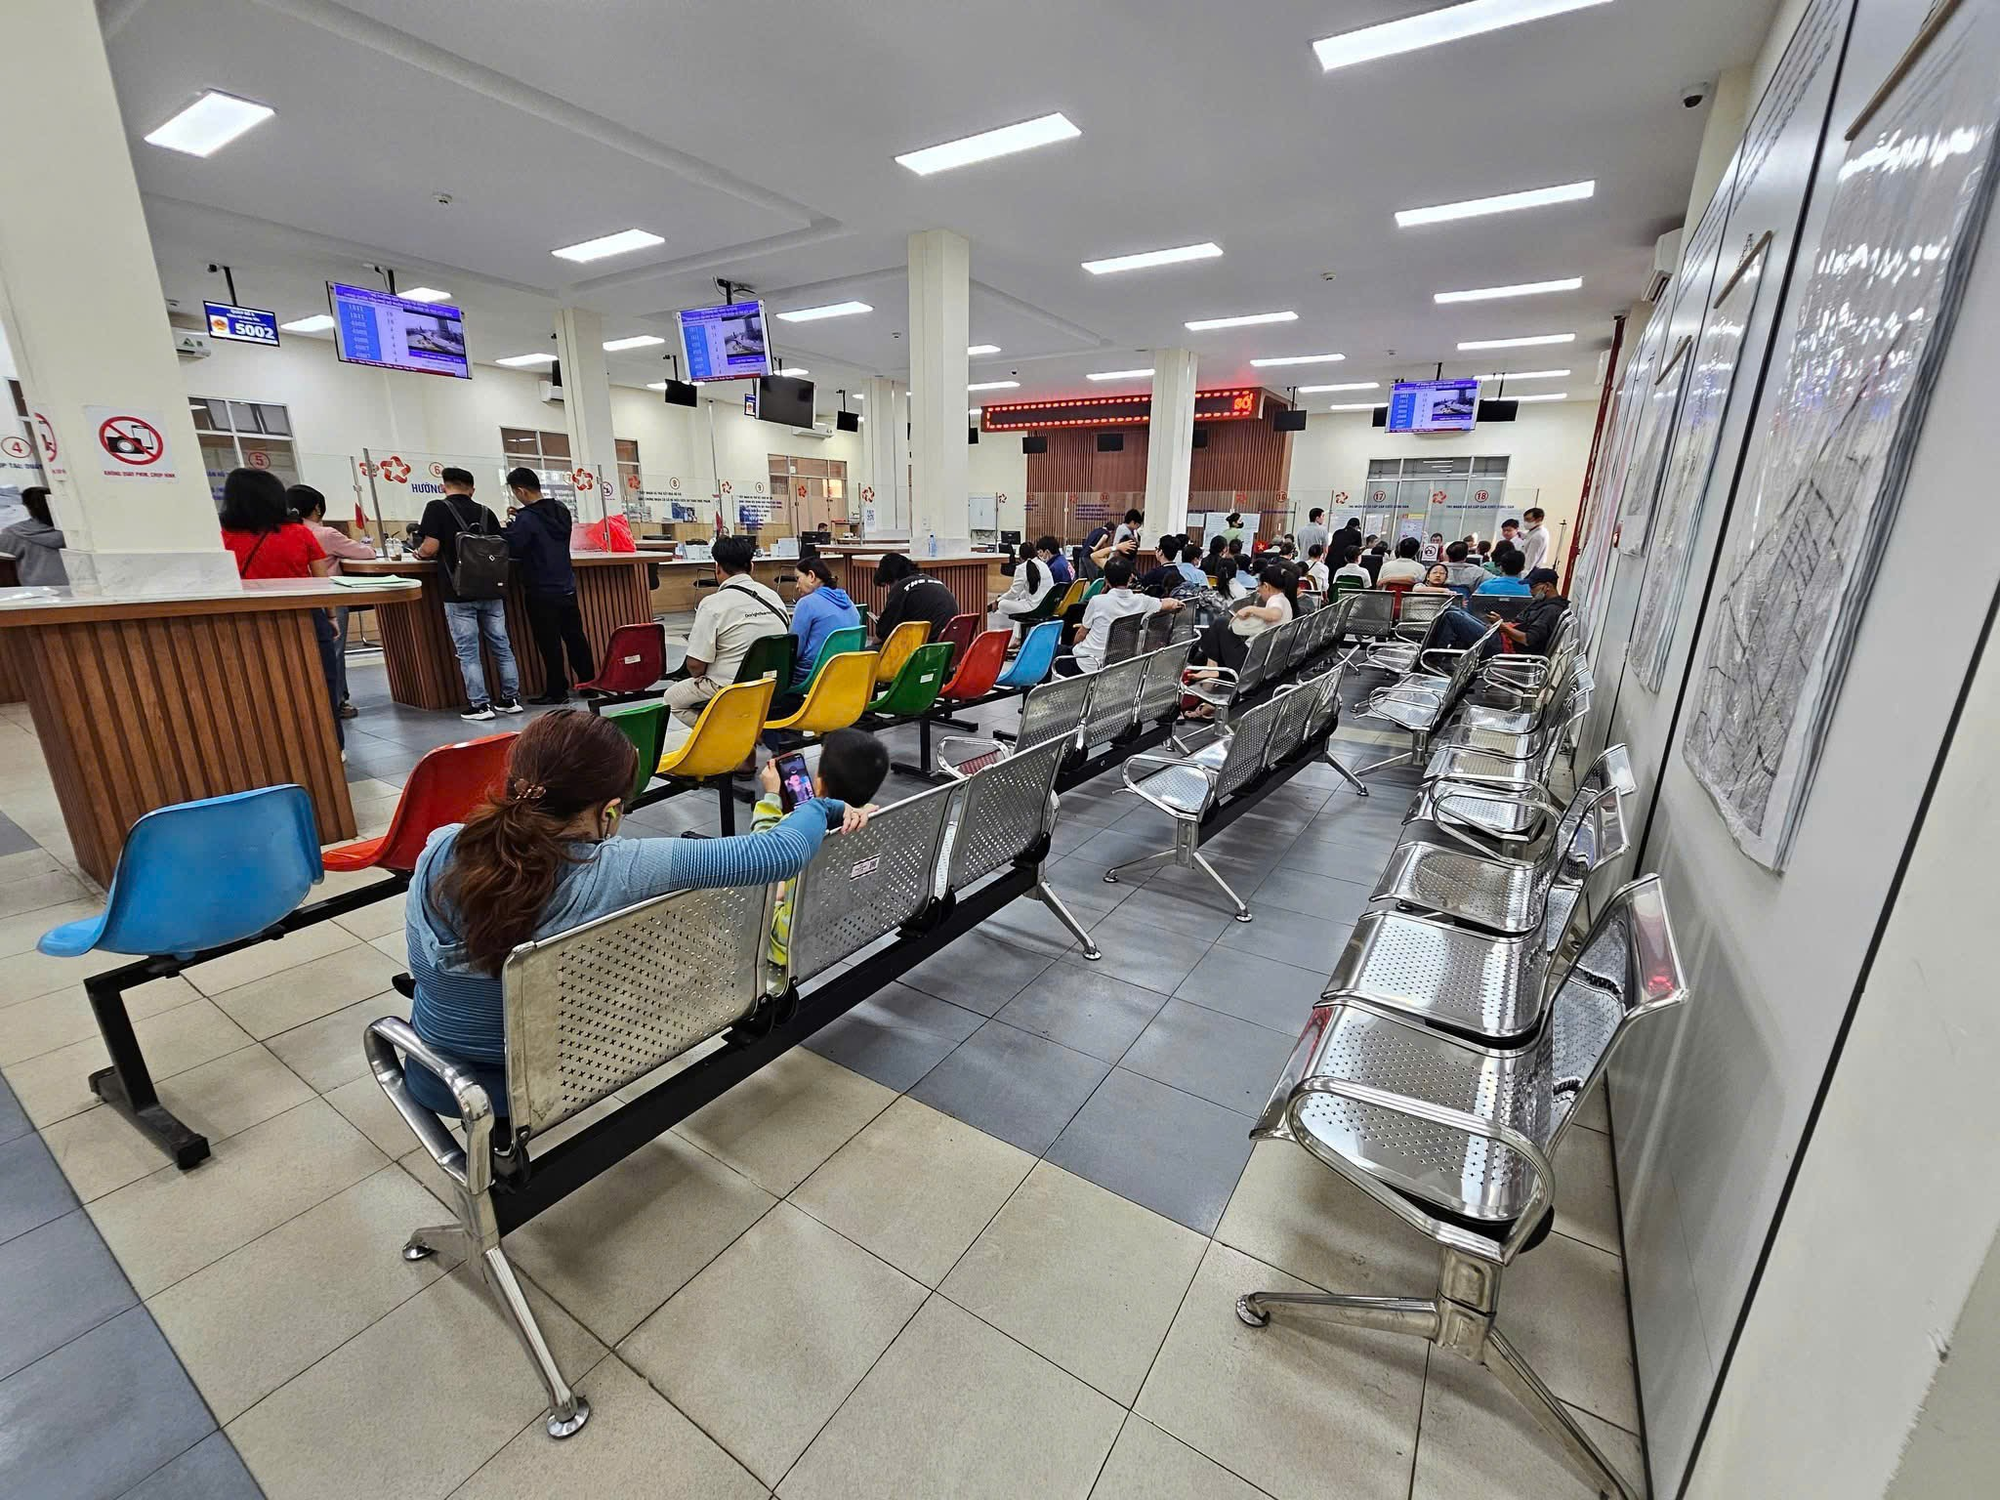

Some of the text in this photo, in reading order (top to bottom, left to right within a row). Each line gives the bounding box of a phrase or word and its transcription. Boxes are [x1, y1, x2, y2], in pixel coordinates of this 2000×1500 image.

[235, 323, 275, 339] 5002
[12, 441, 23, 453] 4
[255, 454, 265, 466] 5
[434, 465, 441, 475] 6
